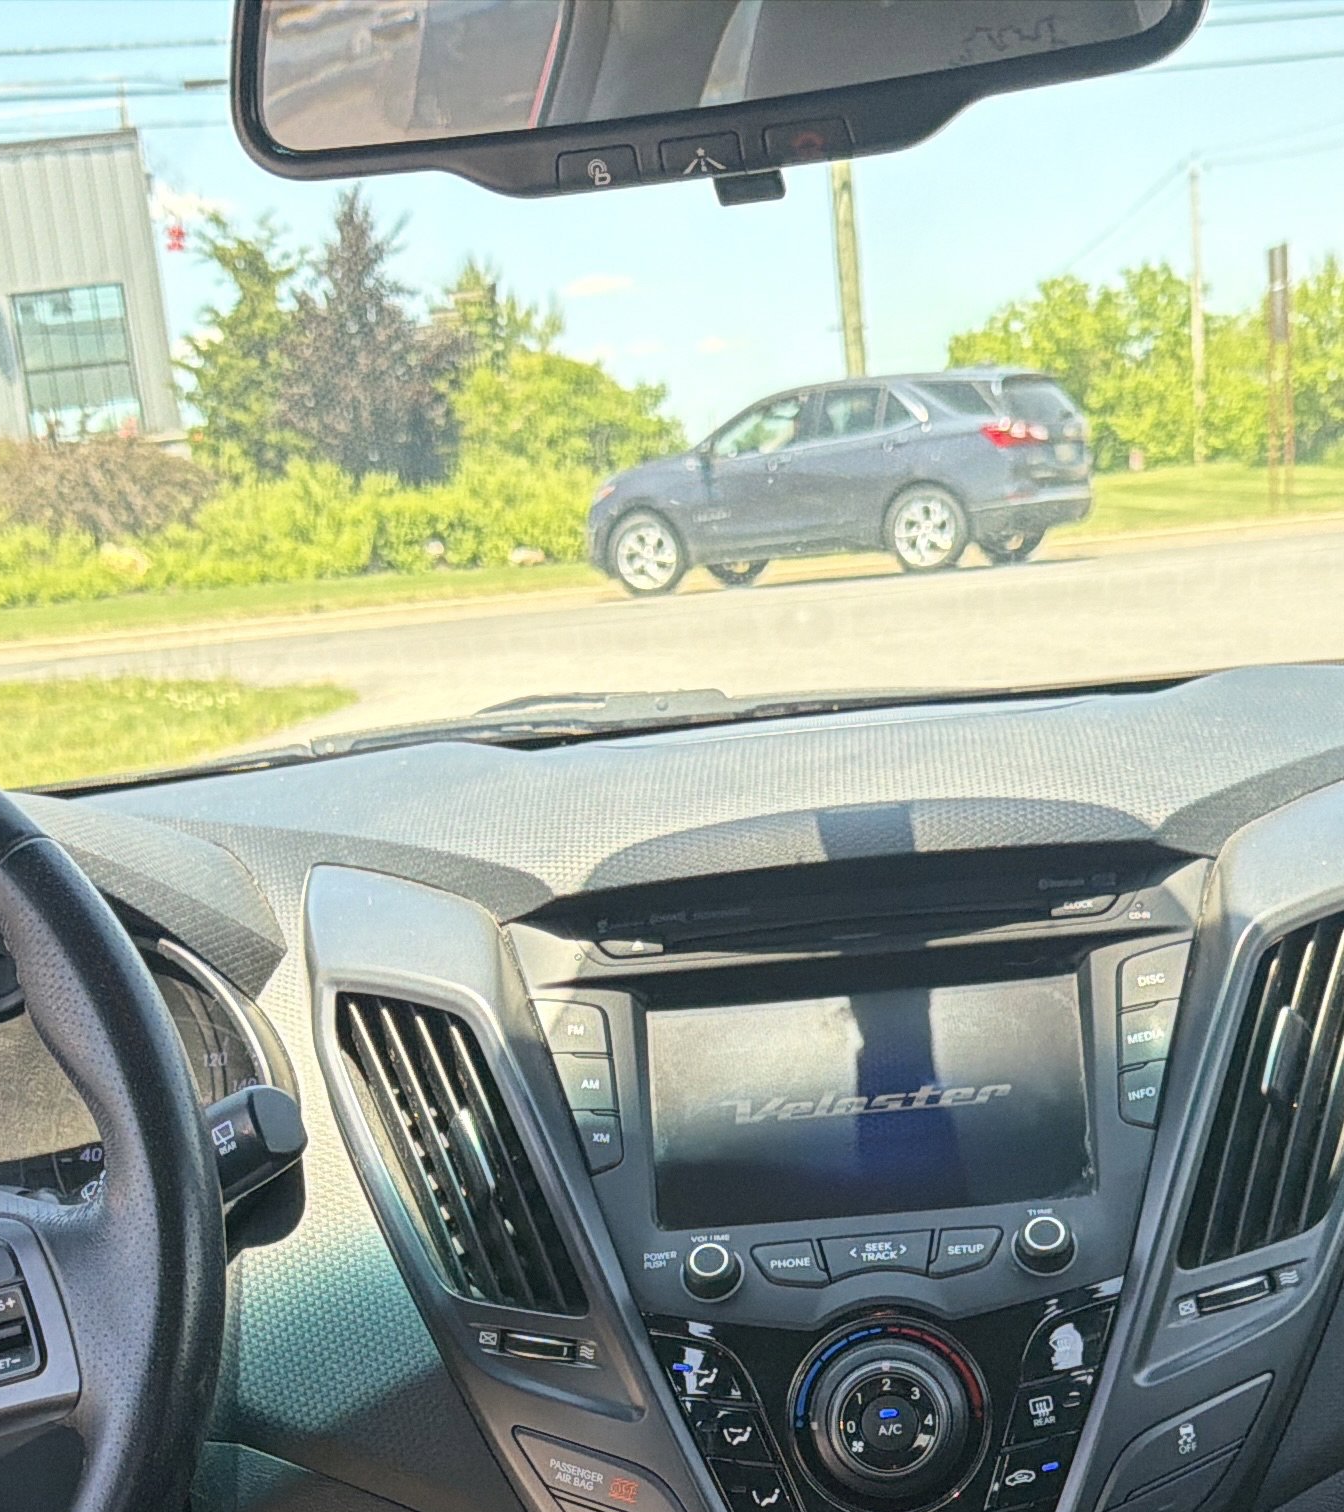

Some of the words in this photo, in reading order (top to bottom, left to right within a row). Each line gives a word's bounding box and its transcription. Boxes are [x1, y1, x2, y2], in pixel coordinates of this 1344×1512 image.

[1137, 973, 1165, 987] DISC
[567, 1024, 585, 1036] FM
[1127, 1029, 1165, 1045] MEDIA
[203, 1051, 228, 1067] 120
[581, 1079, 600, 1090] AM
[1127, 1086, 1156, 1102] INFO
[720, 1083, 1012, 1125] Veloster
[592, 1132, 610, 1144] XM
[80, 1147, 103, 1162] 40
[218, 1141, 237, 1156] REAR
[864, 1241, 893, 1252] SEEK
[947, 1243, 985, 1256] SETUP
[643, 1251, 677, 1262] POWER
[860, 1250, 898, 1262] TRACK
[643, 1260, 668, 1270] PUSH
[770, 1257, 812, 1270] PHONE
[881, 1378, 892, 1391] 2
[855, 1393, 862, 1405] 1
[910, 1387, 921, 1400] 3
[924, 1413, 934, 1427] 4
[1033, 1415, 1056, 1428] REAR
[846, 1420, 856, 1434] 0
[878, 1424, 903, 1437] A/C
[1178, 1442, 1197, 1455] OFF
[550, 1458, 603, 1484] PASSENGER
[555, 1471, 572, 1484] AIR
[573, 1477, 594, 1491] BAG
